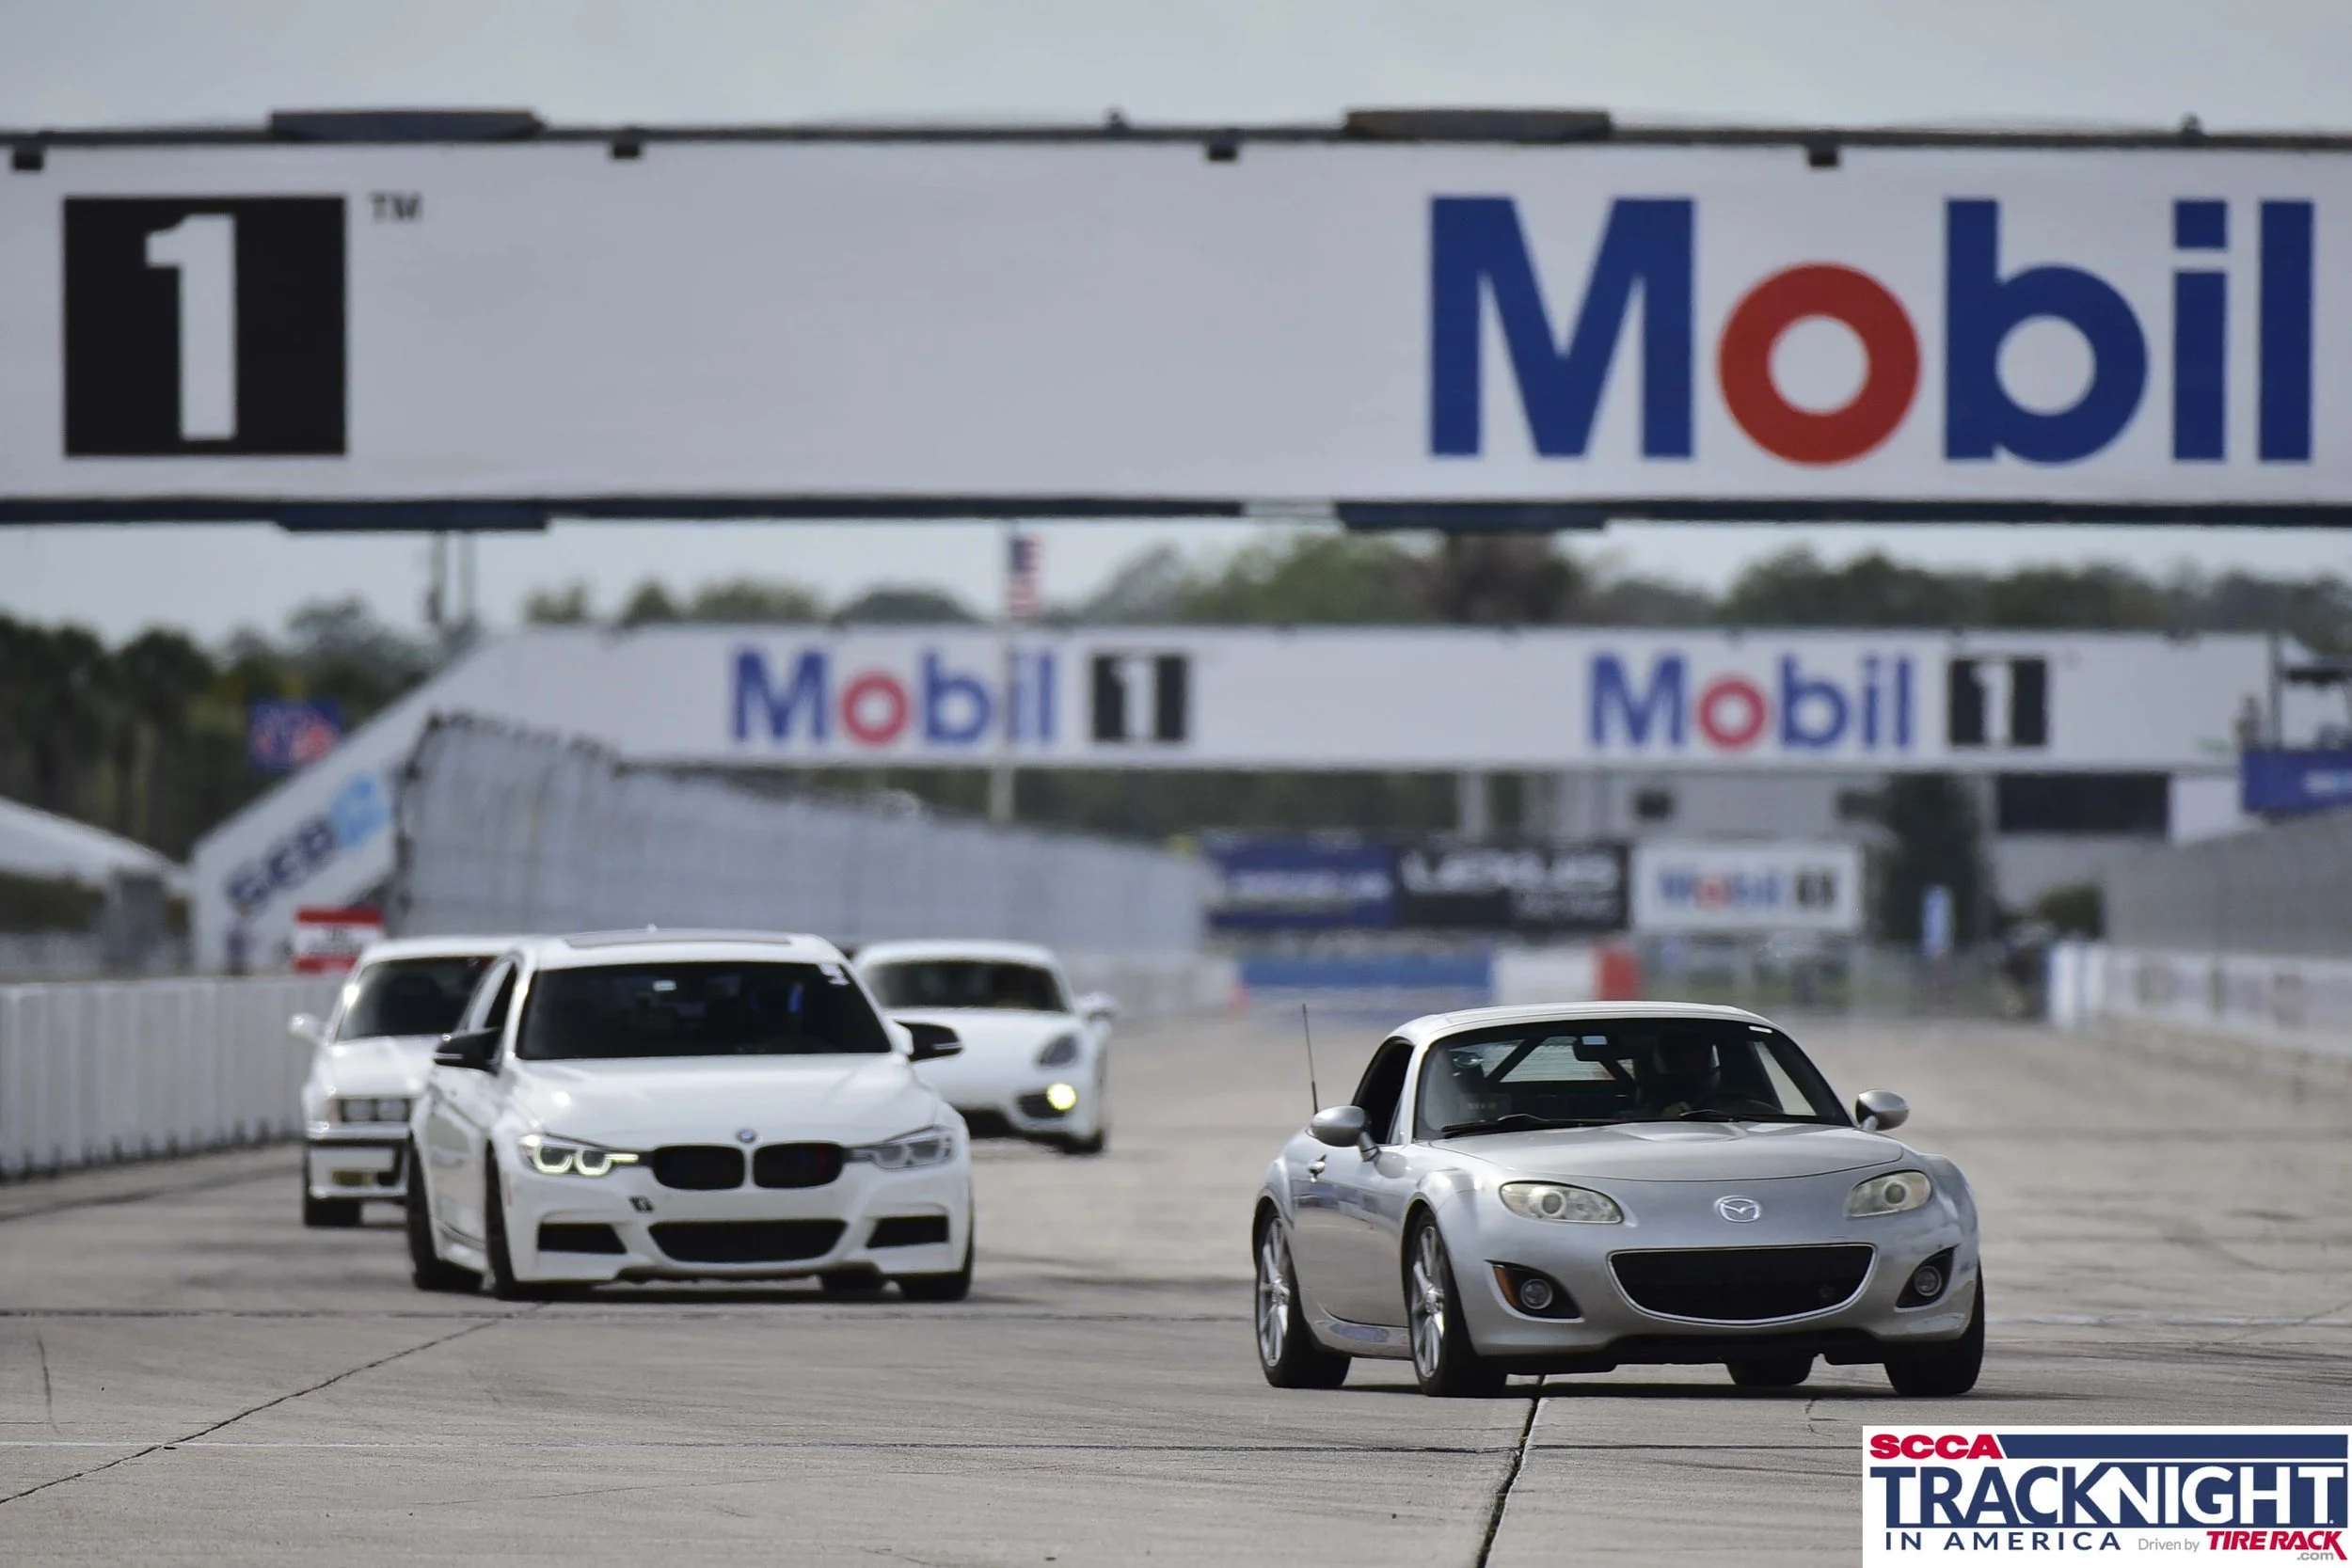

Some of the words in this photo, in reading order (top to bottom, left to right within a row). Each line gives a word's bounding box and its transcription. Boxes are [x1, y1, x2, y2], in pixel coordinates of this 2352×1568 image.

[145, 211, 239, 441] 1
[370, 192, 422, 222] TM
[1428, 195, 2314, 467] Mobil
[731, 649, 1058, 746] Mobil
[1110, 656, 1158, 743] 1
[1589, 654, 1915, 752] Mobil
[1970, 659, 2014, 748] 1
